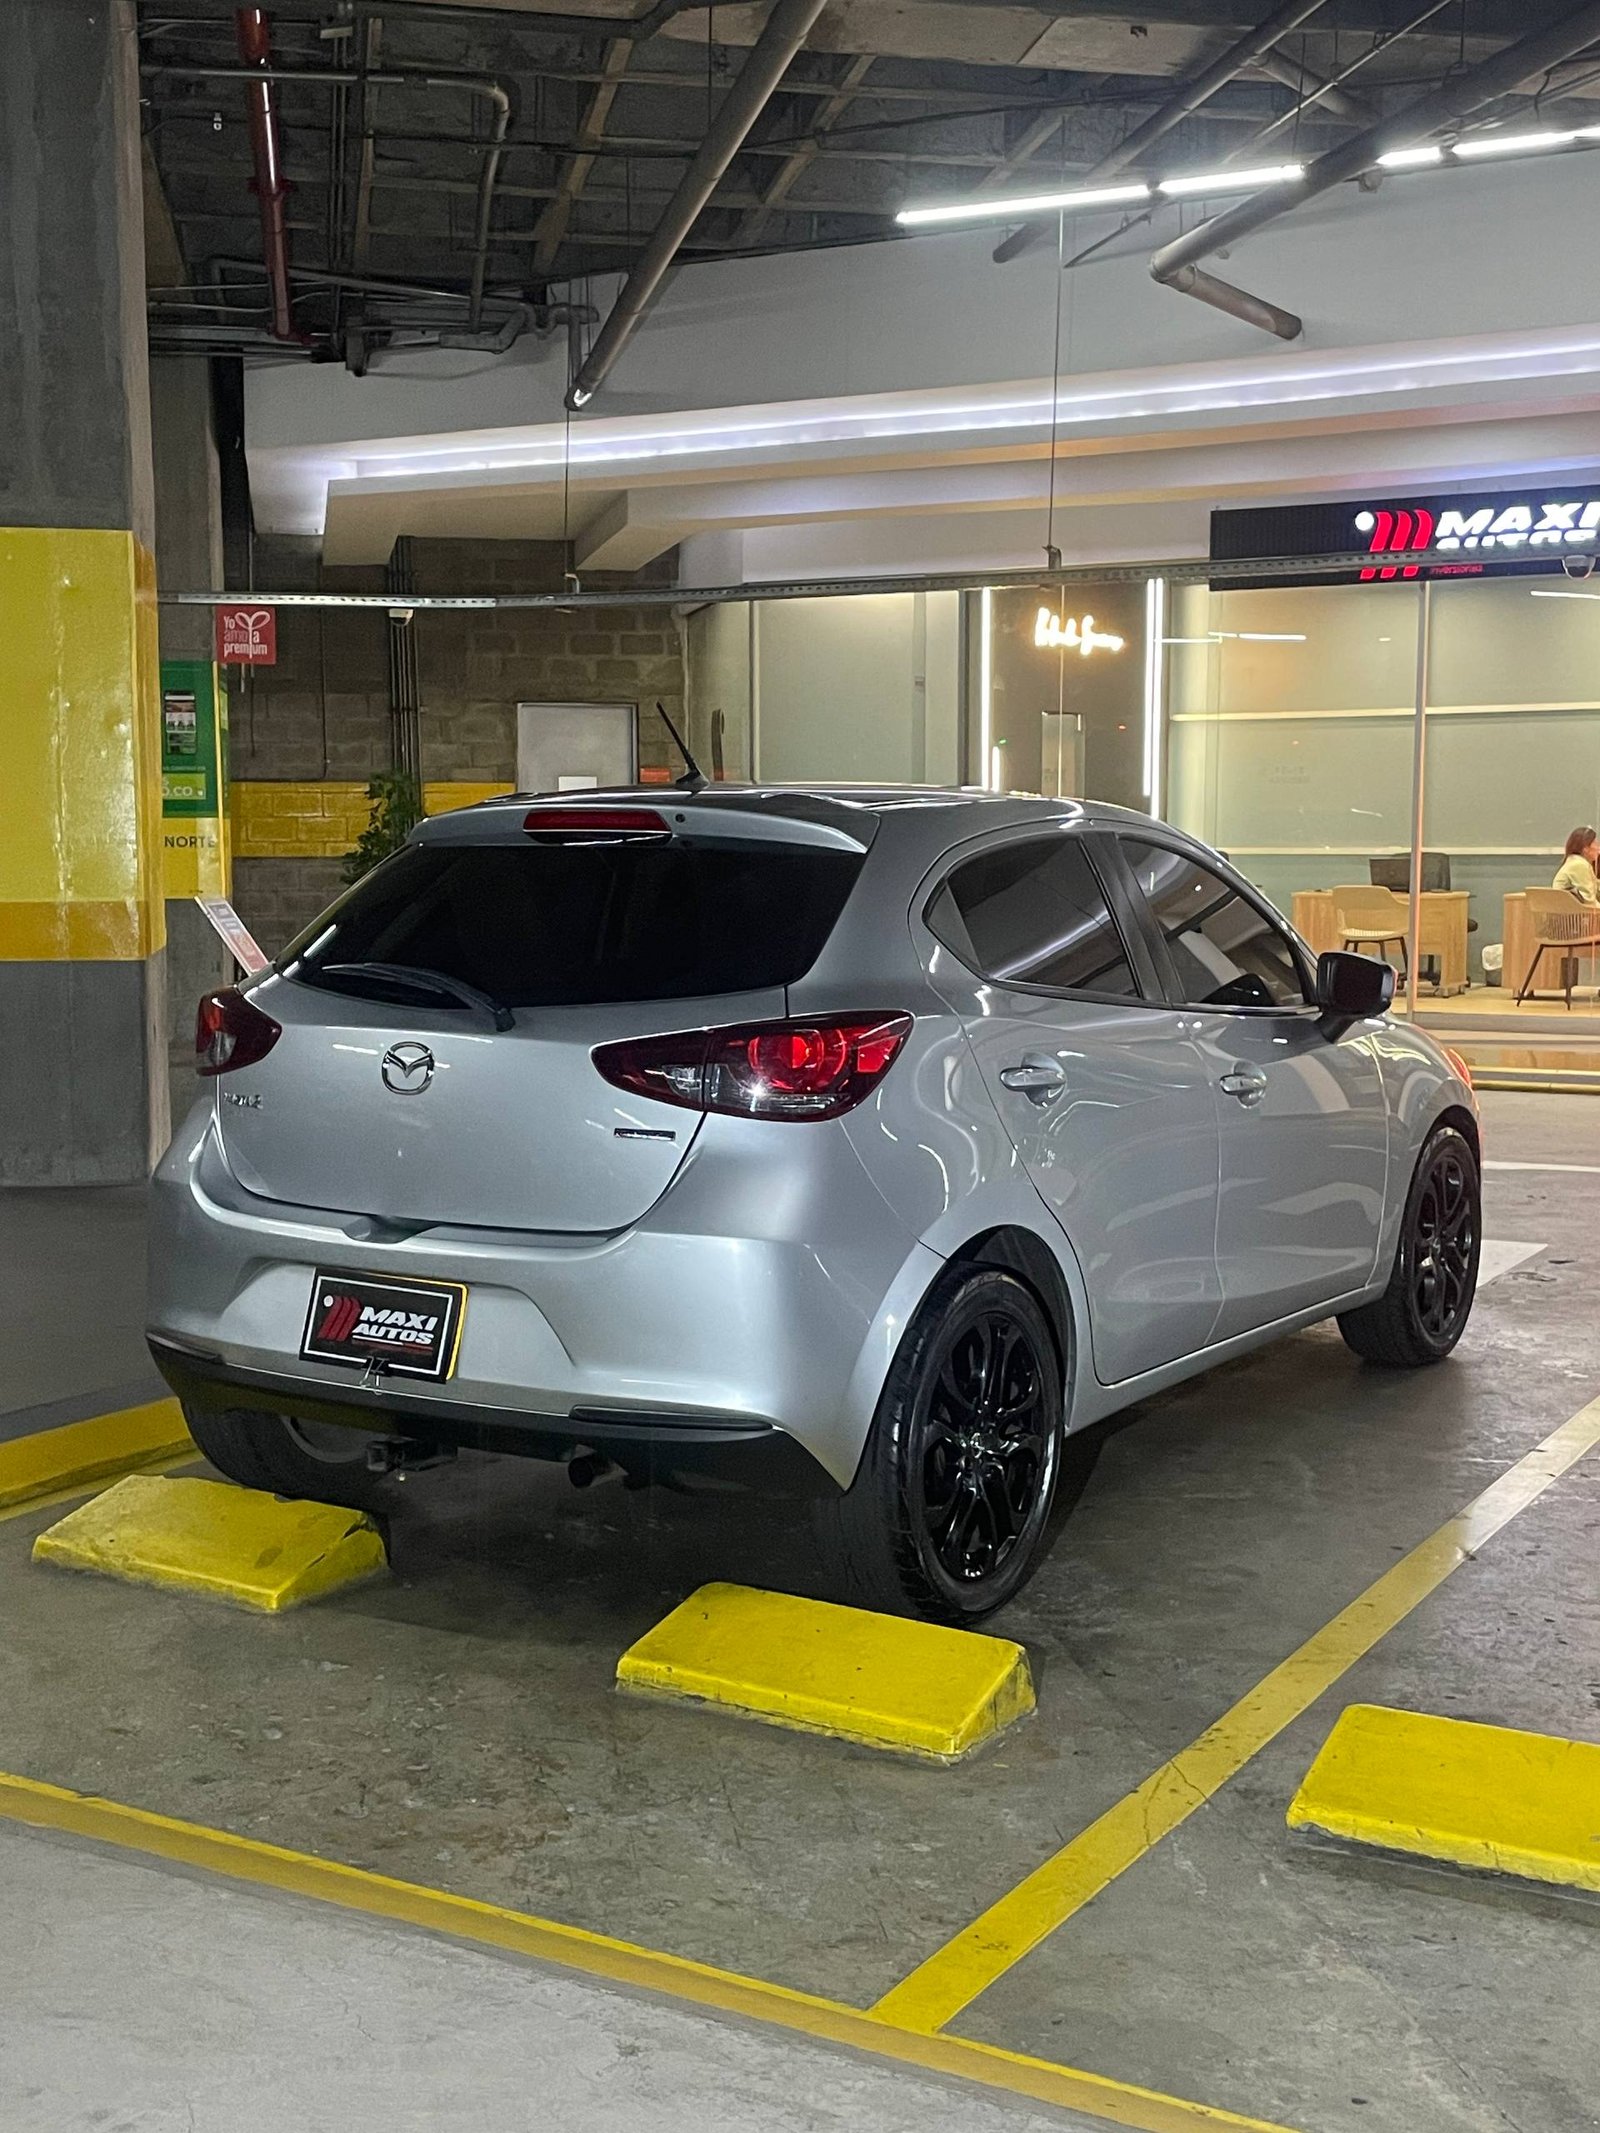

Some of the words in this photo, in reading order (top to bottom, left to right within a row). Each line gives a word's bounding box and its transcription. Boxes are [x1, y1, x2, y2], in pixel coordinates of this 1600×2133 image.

[1435, 501, 1600, 537] MAXI
[223, 615, 236, 630] Yo
[223, 642, 268, 659] premium
[164, 835, 216, 849] NORTE
[359, 1306, 439, 1331] MAXI
[352, 1323, 435, 1345] AUTOS
